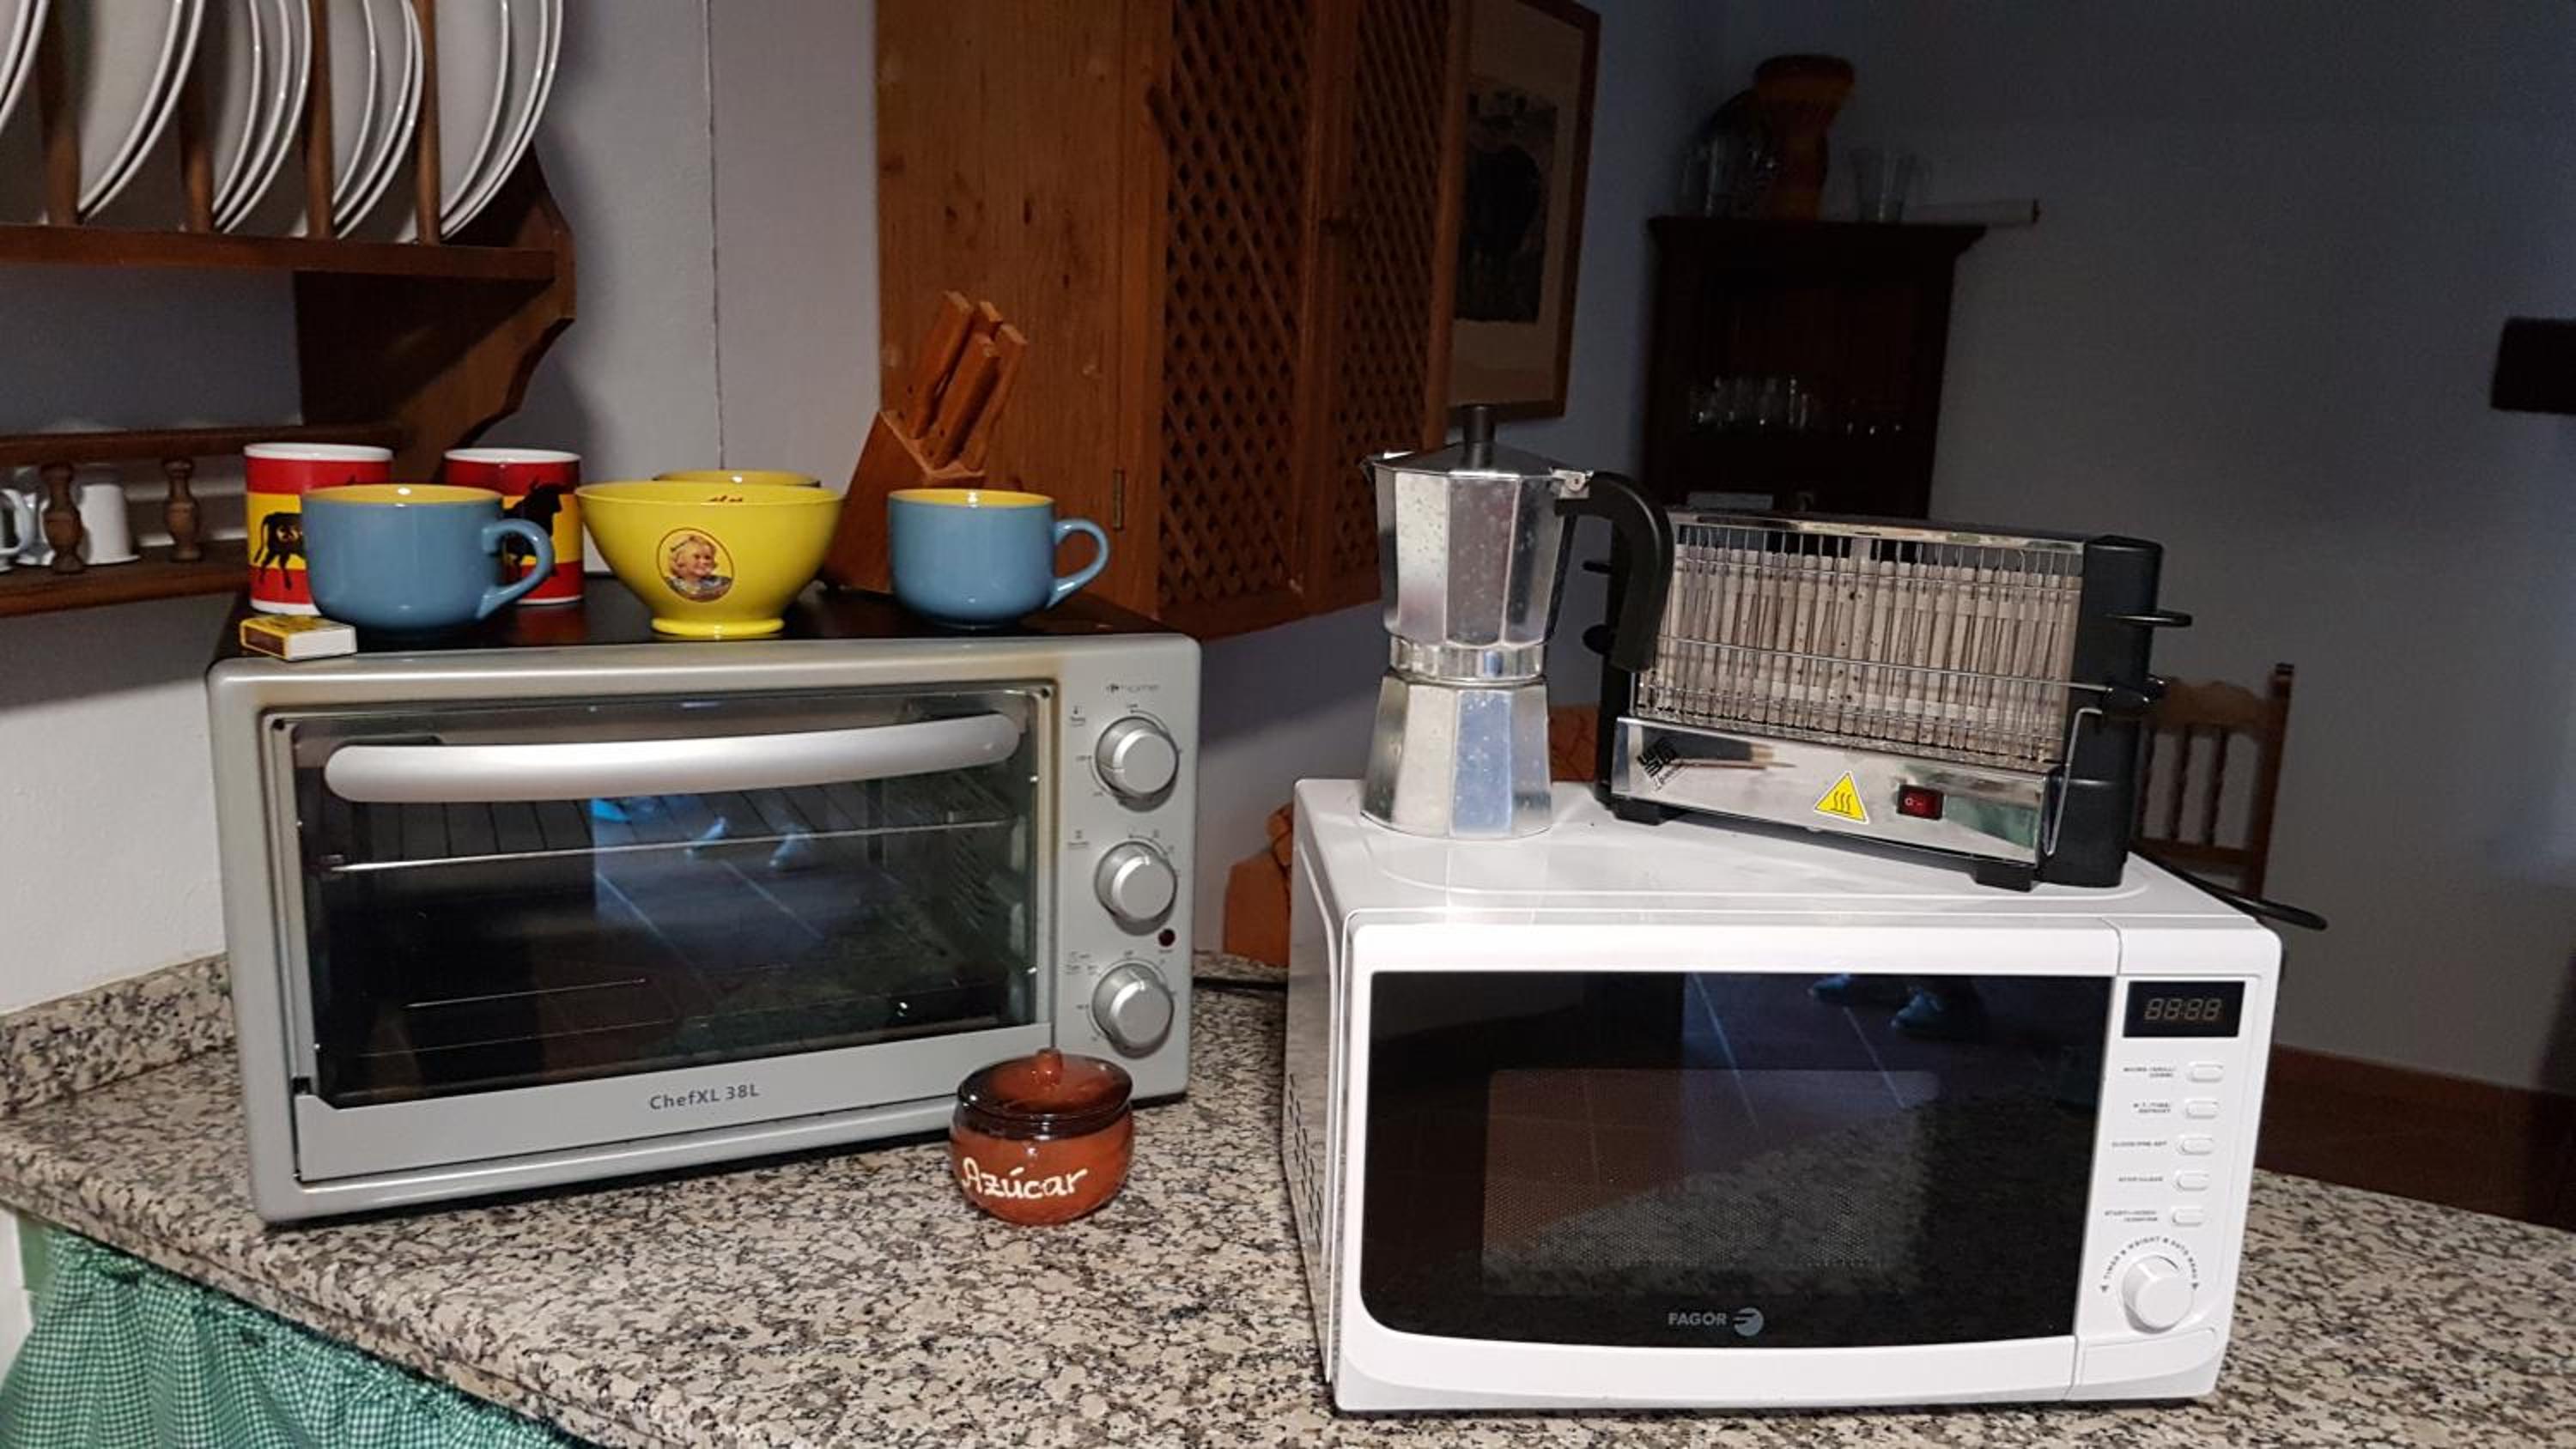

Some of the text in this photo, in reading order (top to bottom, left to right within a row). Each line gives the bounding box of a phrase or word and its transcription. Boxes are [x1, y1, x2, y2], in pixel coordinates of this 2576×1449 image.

[649, 1082, 761, 1110] ChefXL 38L
[961, 1156, 1089, 1199] Azúcar
[1668, 1312, 1728, 1326] FAGOR
